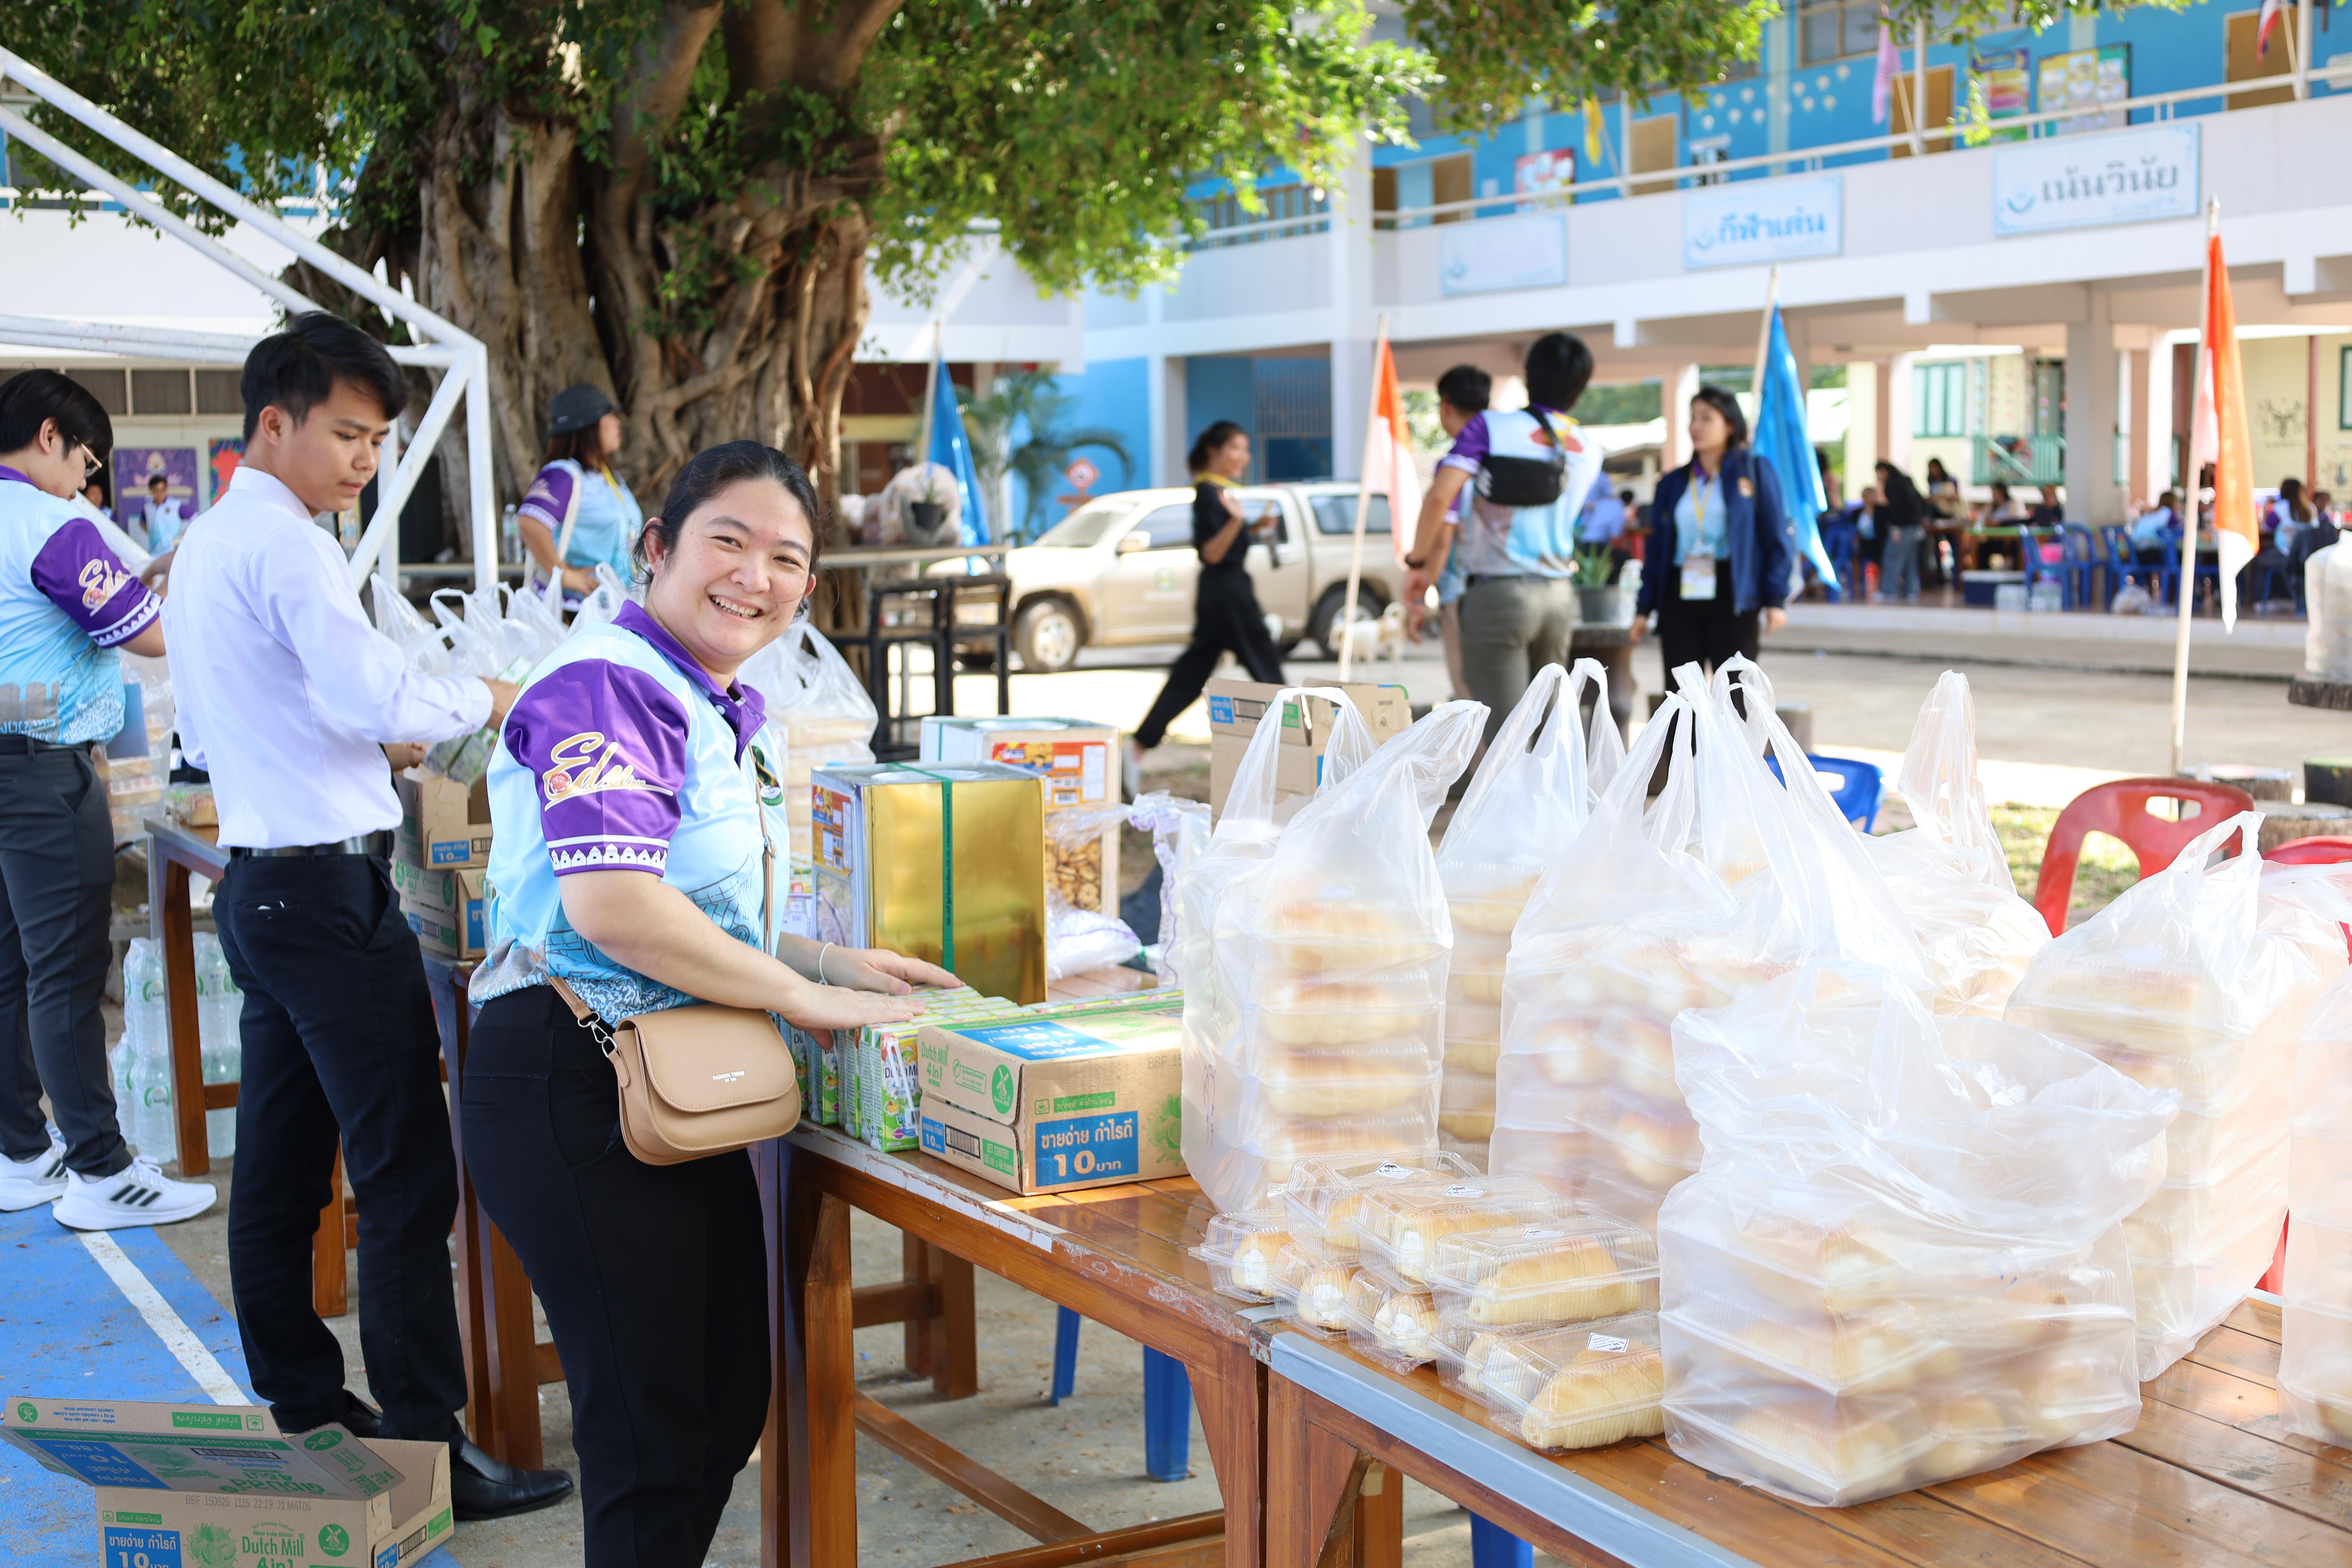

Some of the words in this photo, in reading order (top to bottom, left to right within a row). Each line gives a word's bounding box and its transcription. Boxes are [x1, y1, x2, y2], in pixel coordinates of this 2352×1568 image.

[439, 852, 453, 862] 10
[922, 1041, 937, 1062] Dutch
[938, 1047, 948, 1066] Mill
[1148, 1056, 1167, 1069] BBF
[926, 1133, 935, 1147] 10
[1041, 1125, 1089, 1149] ขายง่าย
[1095, 1118, 1133, 1142] กำไรดี
[994, 1145, 1009, 1160] CONTENT
[1054, 1150, 1095, 1177] 10
[1096, 1161, 1121, 1171] บาท
[176, 1415, 213, 1425] มีประโยชน์
[216, 1417, 238, 1426] อร่อยดี
[89, 1455, 128, 1464] 10
[97, 1475, 151, 1483] ขายง่าย
[186, 1495, 201, 1505] BBF
[204, 1496, 230, 1507] 150825
[234, 1498, 250, 1508] 1115
[254, 1499, 273, 1510] 22:19
[109, 1533, 144, 1548] ขายง่าย
[148, 1534, 176, 1550] กำไรดี
[242, 1536, 277, 1556] Dutch
[282, 1538, 304, 1557] Mill
[119, 1551, 150, 1568] 10
